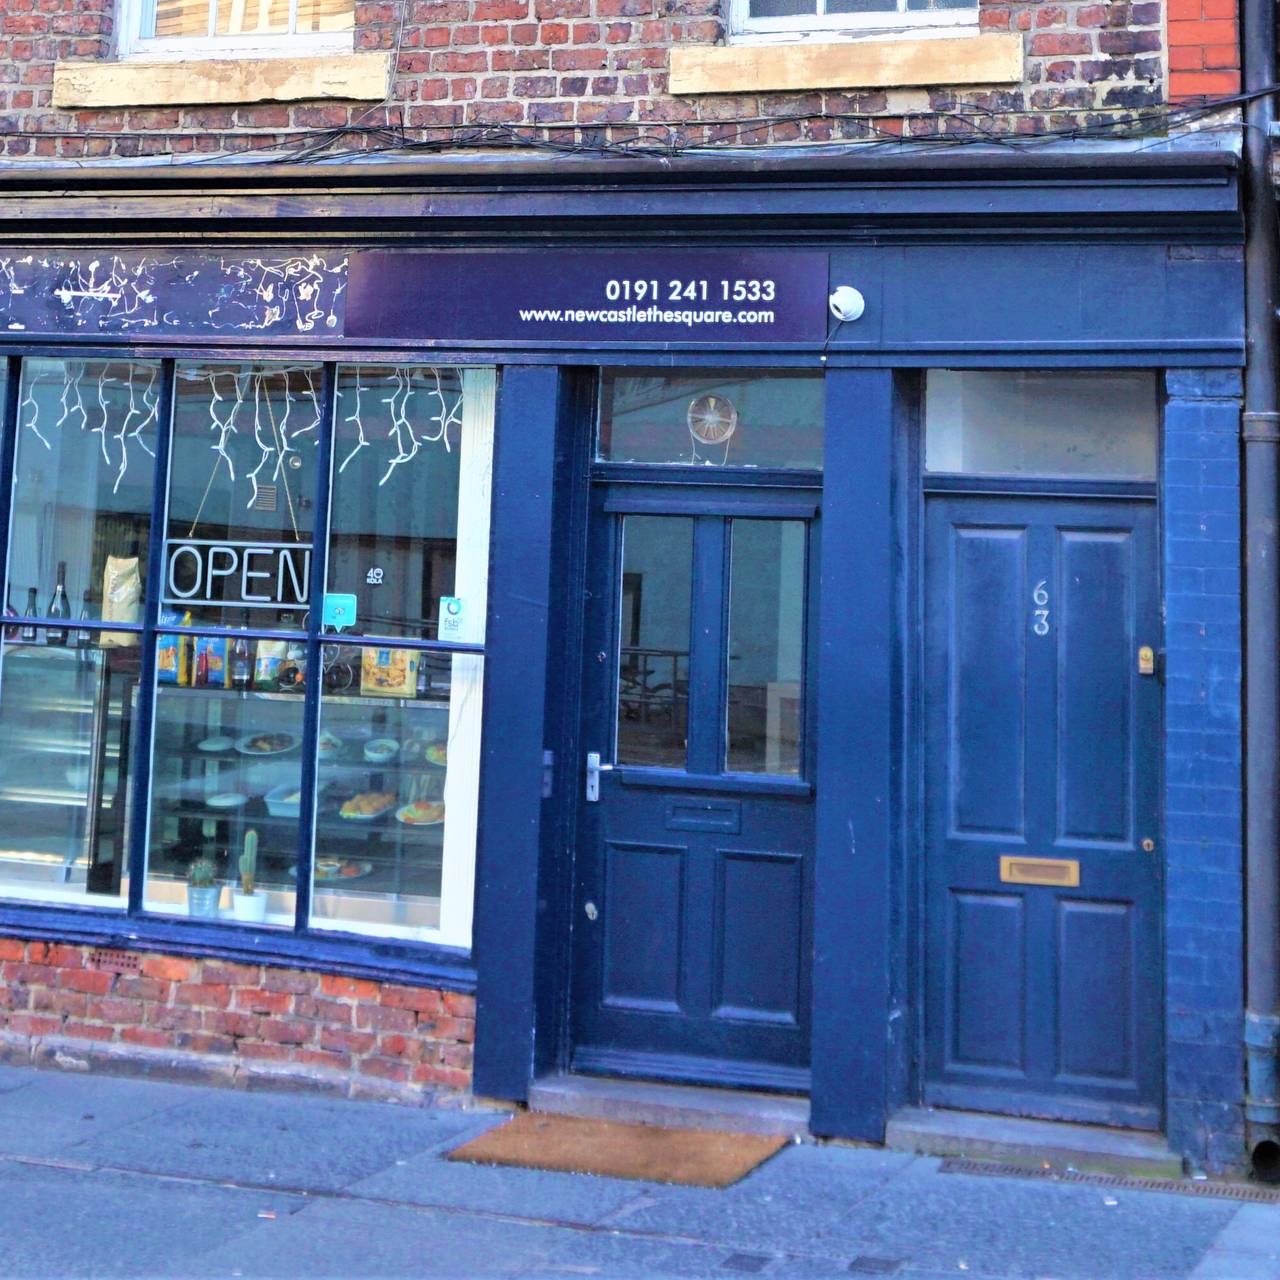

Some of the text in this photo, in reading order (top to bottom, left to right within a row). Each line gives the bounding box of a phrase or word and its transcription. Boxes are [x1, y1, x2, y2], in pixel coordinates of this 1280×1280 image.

[606, 280, 775, 300] 0191 241 1533
[519, 305, 774, 326] www.newcastlethesquare.com
[170, 546, 310, 603] OPEN
